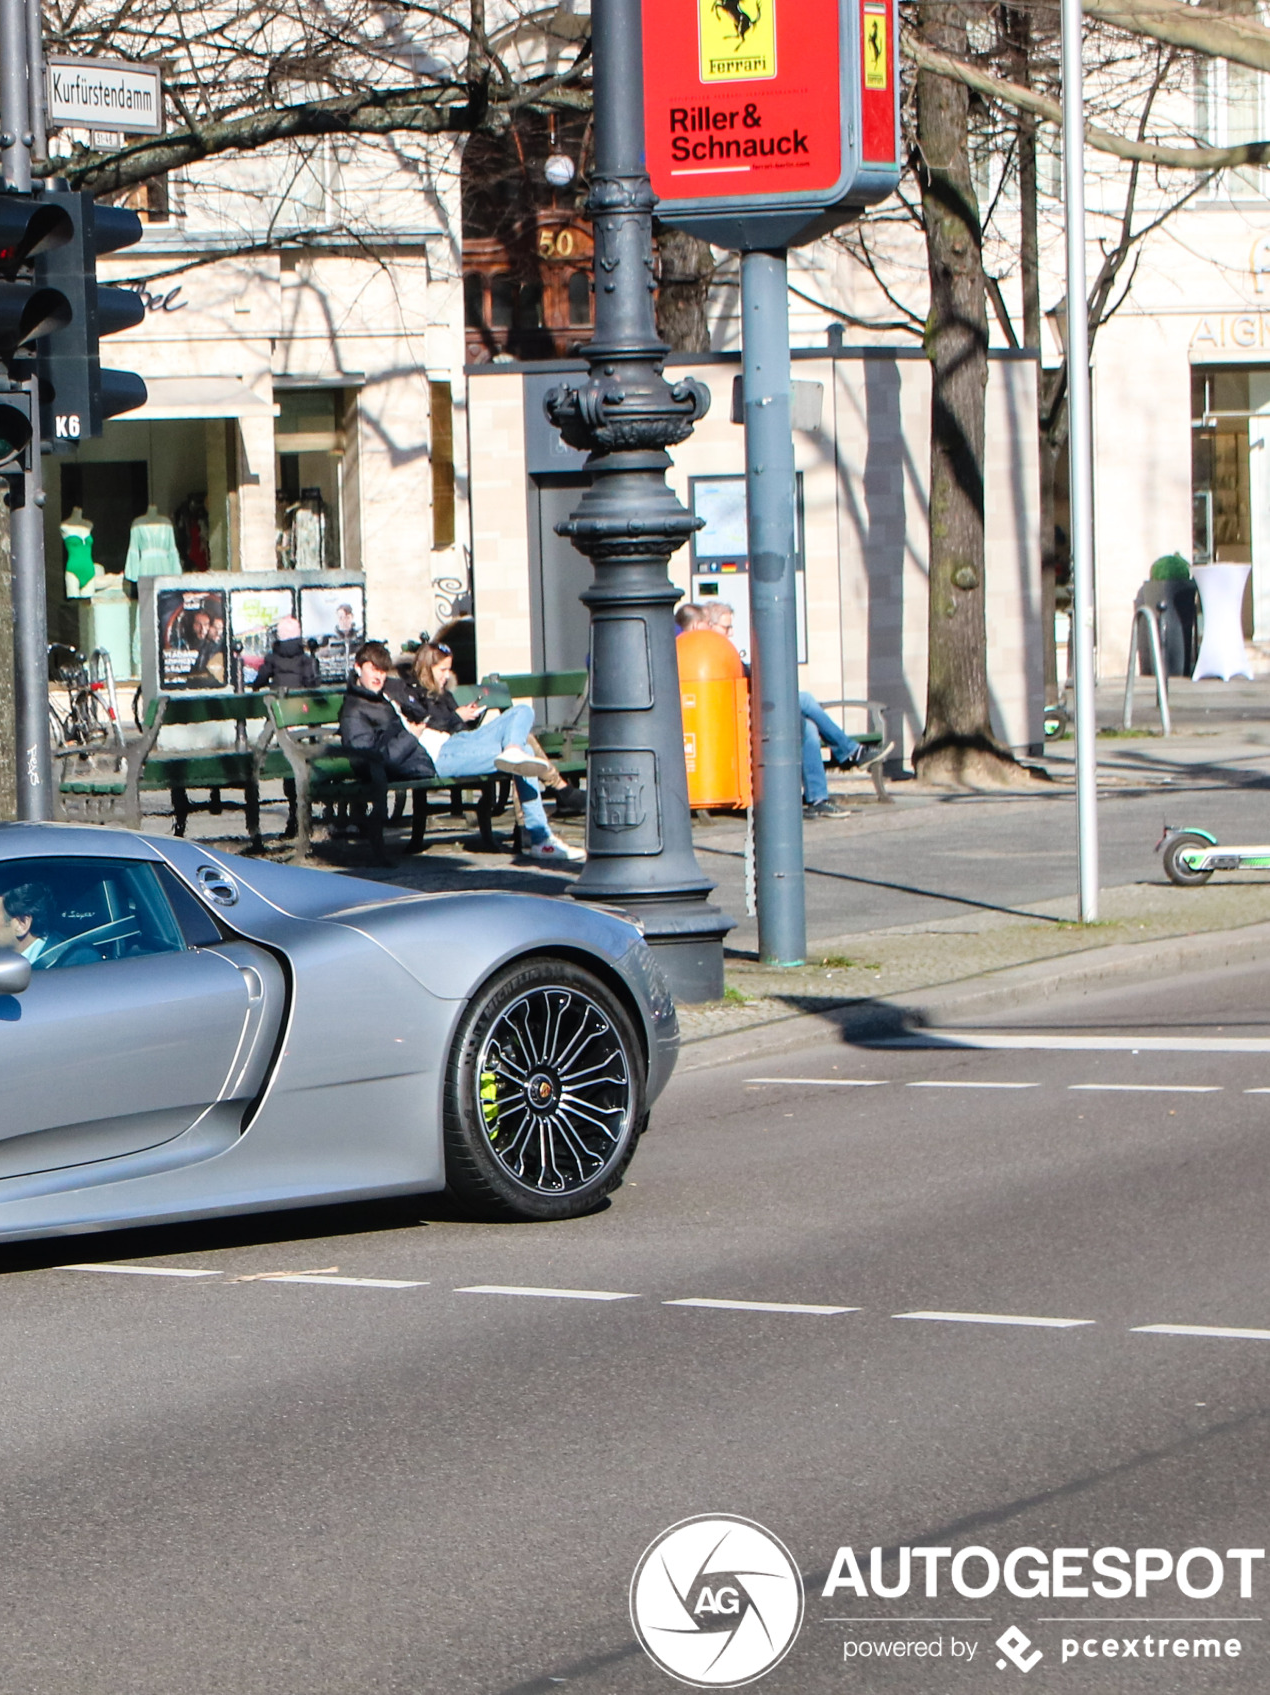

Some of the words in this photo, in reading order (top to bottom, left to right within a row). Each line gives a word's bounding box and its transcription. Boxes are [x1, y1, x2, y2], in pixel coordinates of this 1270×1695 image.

[709, 56, 766, 75] Ferrari
[53, 72, 152, 111] Kurfürstendamm
[670, 106, 739, 133] Riller
[742, 103, 762, 129] &
[671, 129, 810, 161] Schnauck
[538, 229, 573, 259] 50
[55, 415, 80, 438] K6
